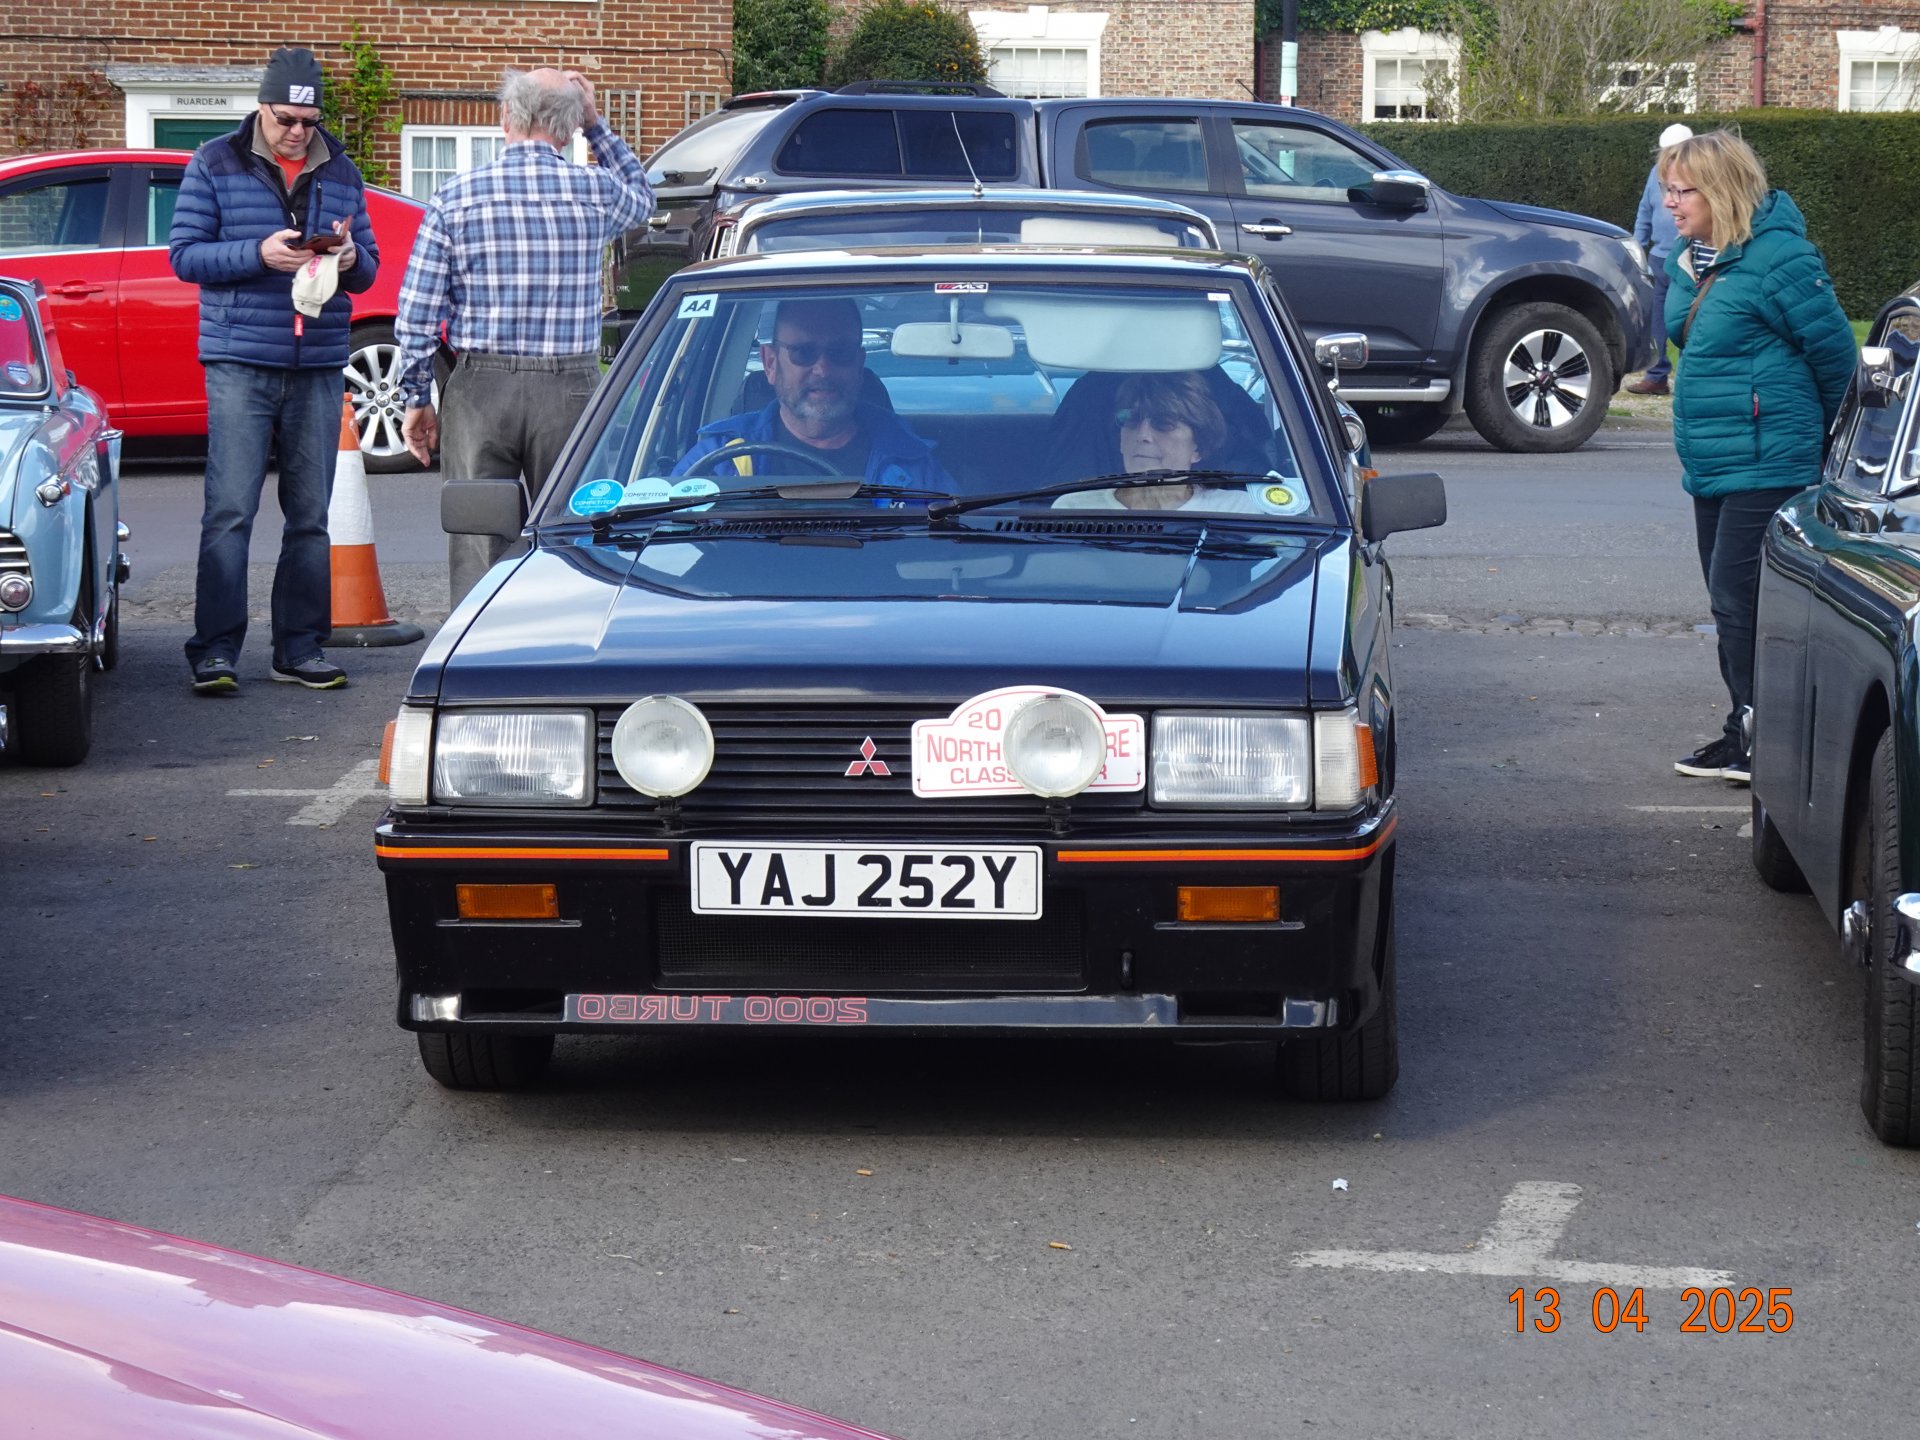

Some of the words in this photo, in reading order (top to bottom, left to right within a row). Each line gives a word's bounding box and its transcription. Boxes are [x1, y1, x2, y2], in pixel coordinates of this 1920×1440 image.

[176, 97, 227, 106] RUARDEAN
[683, 299, 711, 312] AA
[950, 766, 1017, 784] CLASS
[718, 852, 836, 906] YAJ
[857, 854, 1017, 909] 252Y
